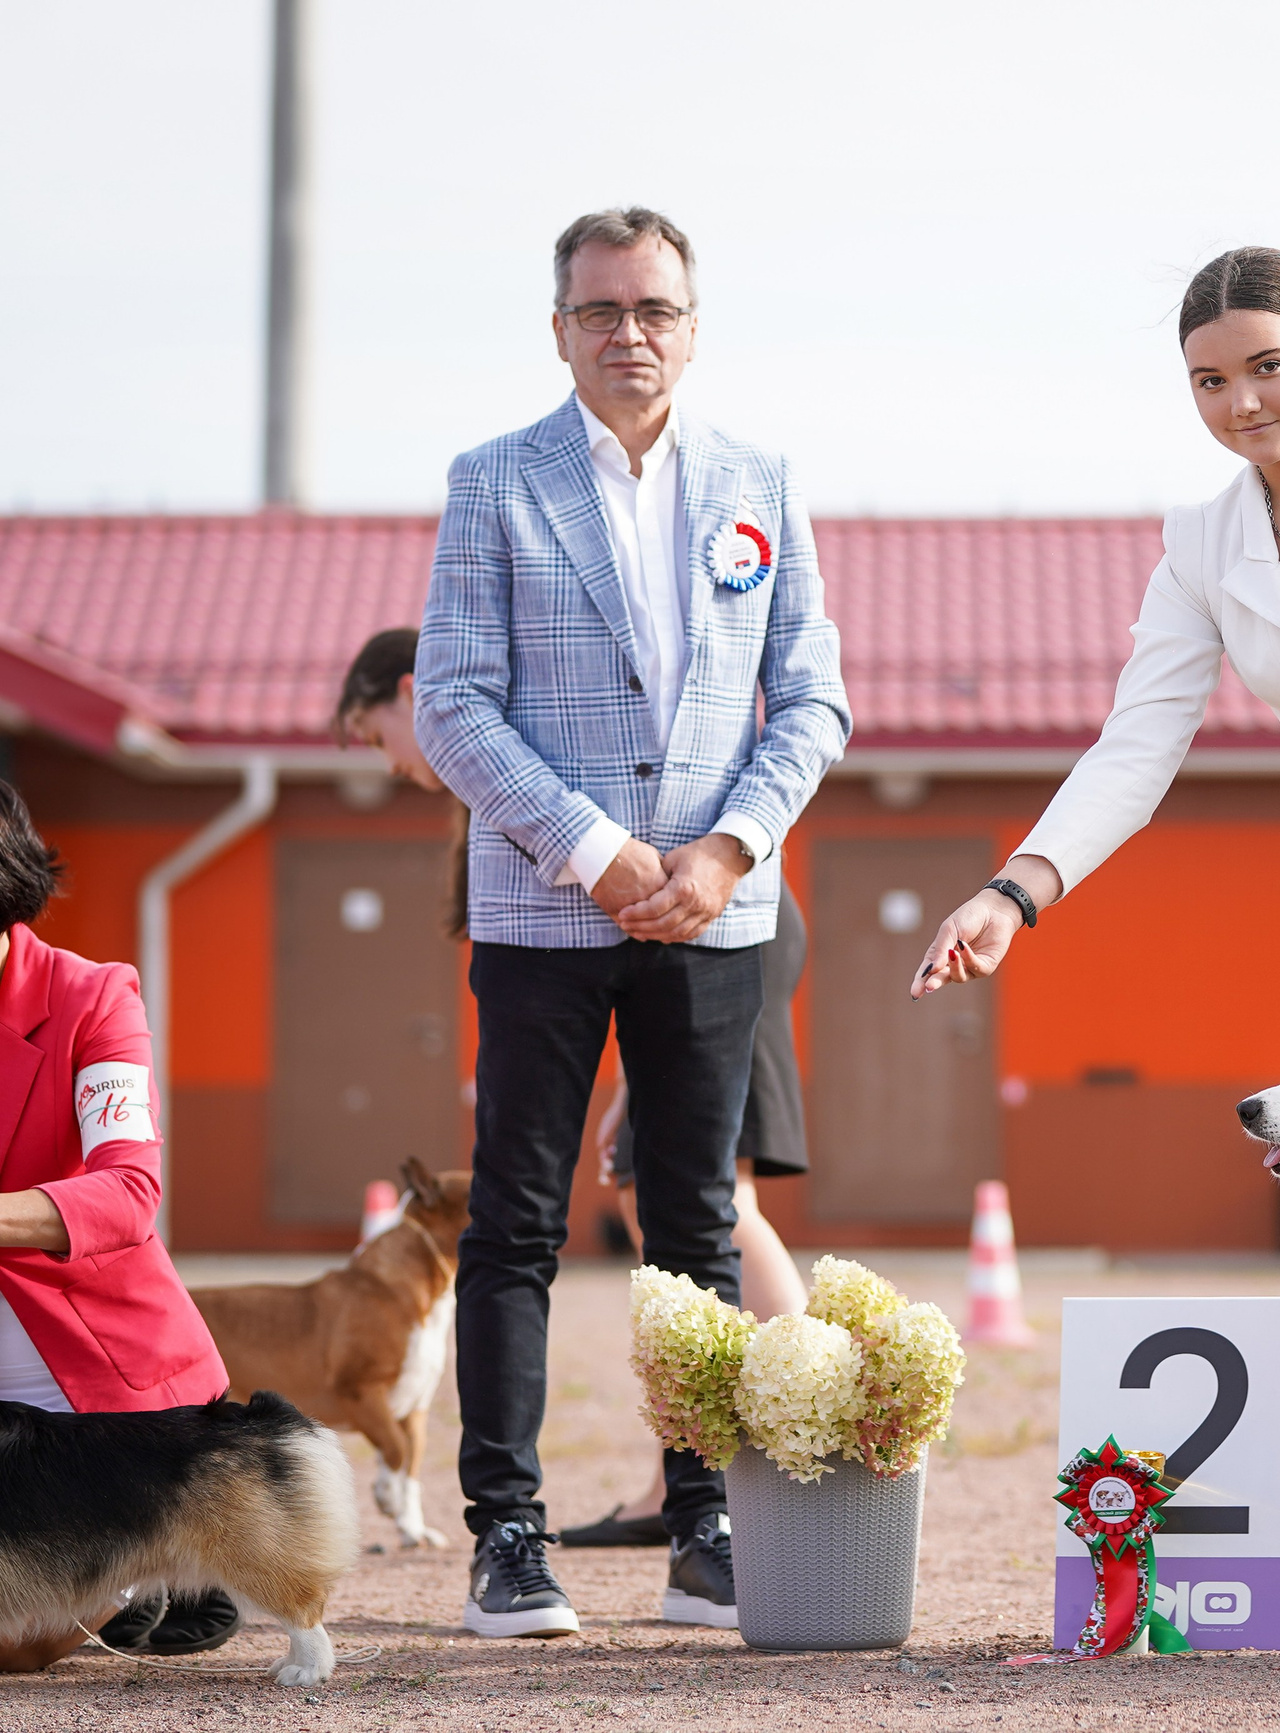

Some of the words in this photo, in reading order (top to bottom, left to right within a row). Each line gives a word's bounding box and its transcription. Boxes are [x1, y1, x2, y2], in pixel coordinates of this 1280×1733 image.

[89, 1078, 136, 1098] SIRIUS
[97, 1092, 130, 1128] 16
[1119, 1326, 1250, 1535] 2
